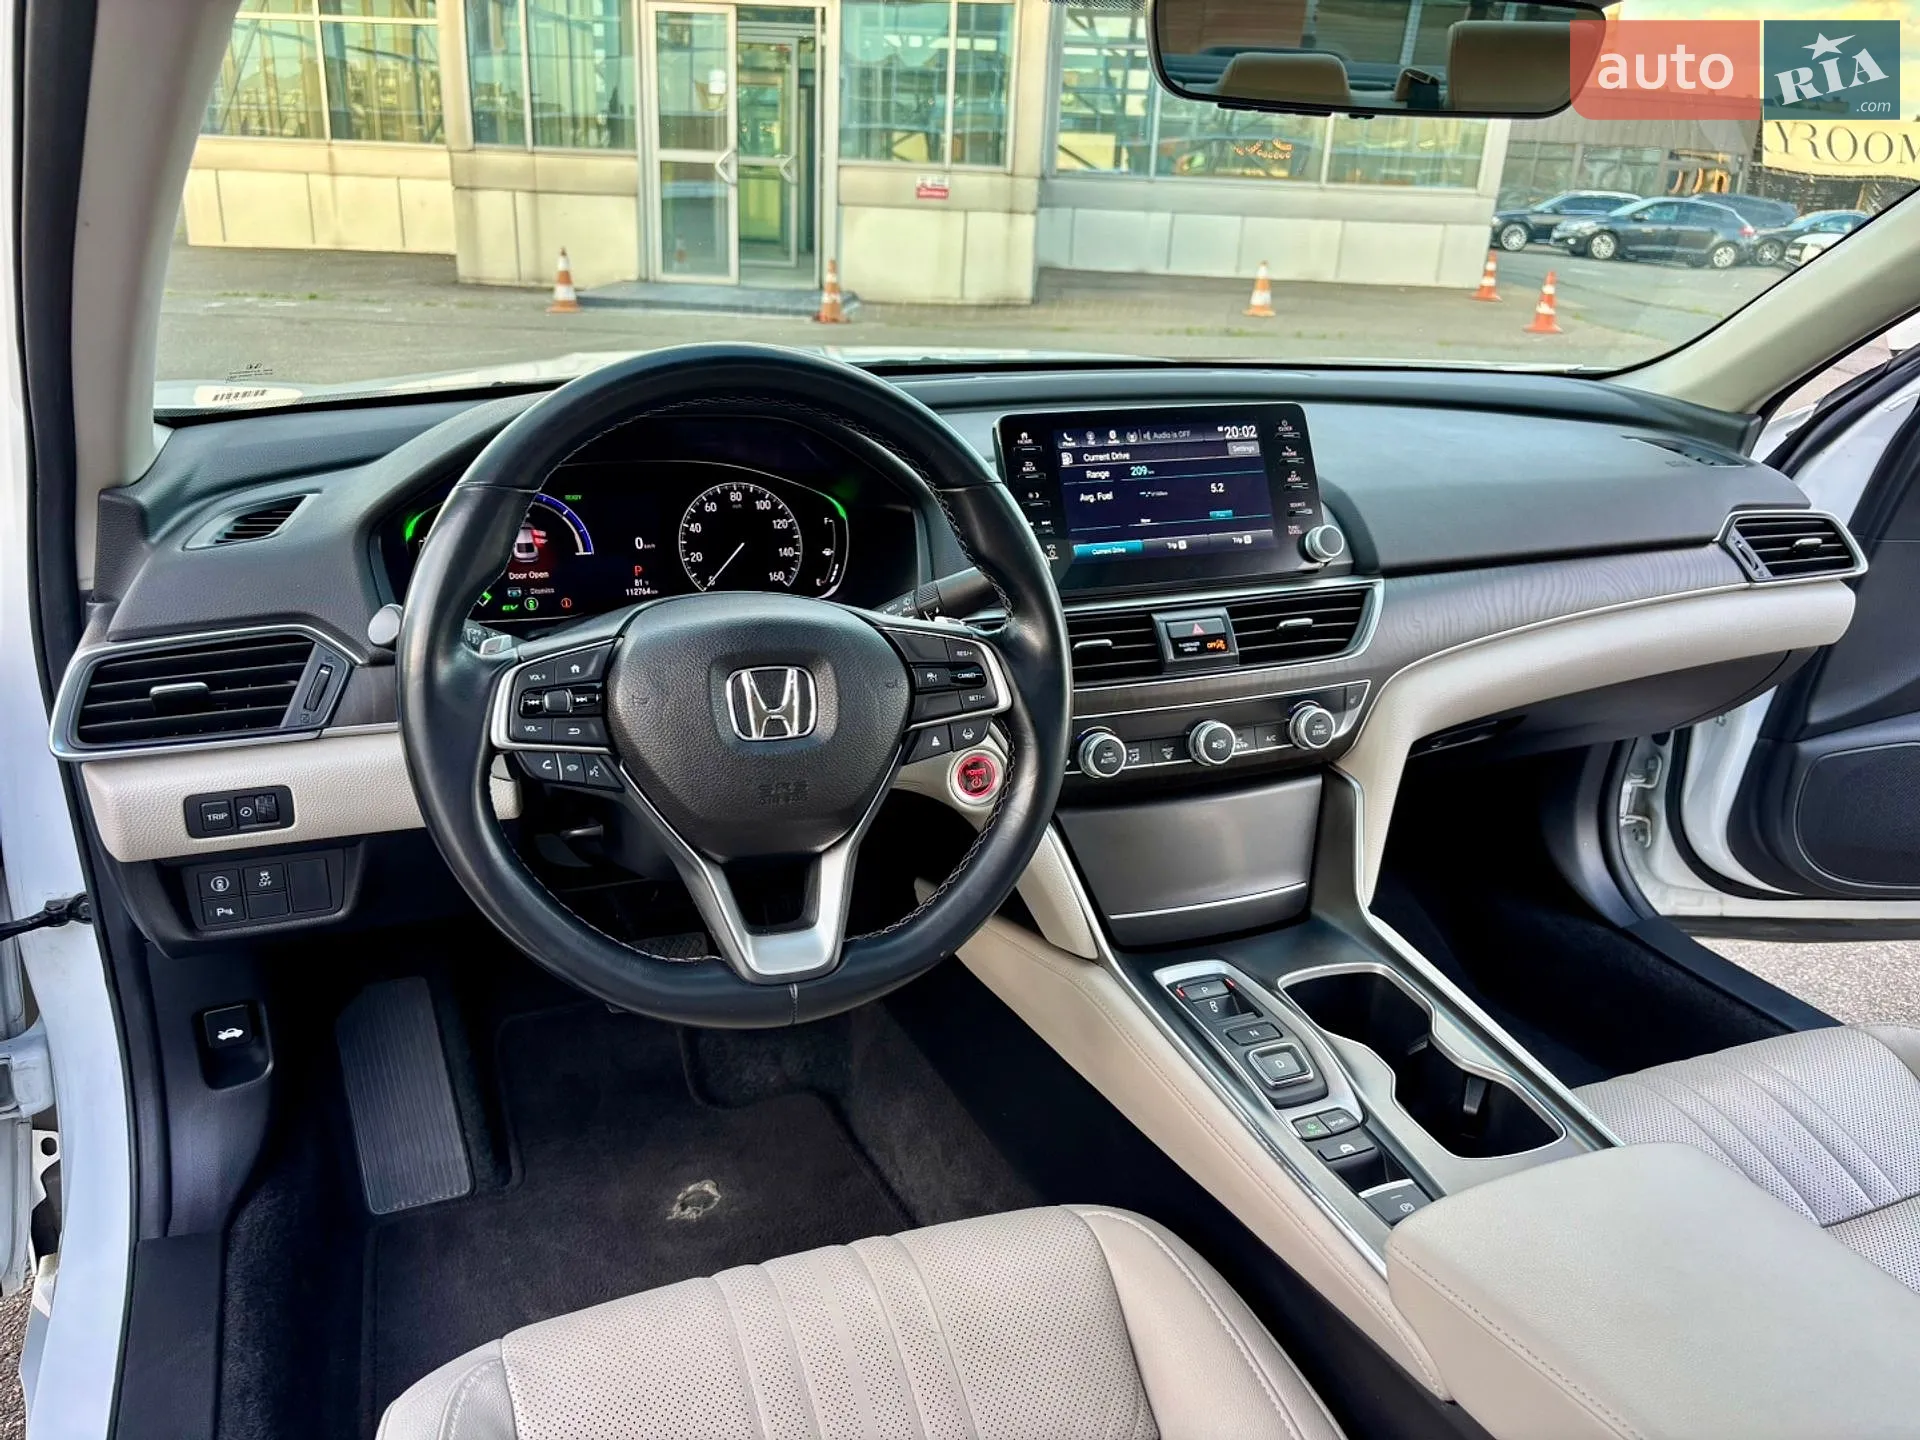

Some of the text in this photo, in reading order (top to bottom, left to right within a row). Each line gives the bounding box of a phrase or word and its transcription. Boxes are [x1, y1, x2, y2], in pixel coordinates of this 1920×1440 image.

[1764, 120, 1920, 164] YROOM
[1153, 431, 1170, 440] Audio
[1178, 430, 1191, 438] OFF
[1223, 425, 1258, 439] 20:02
[1232, 444, 1256, 454] Settings
[1083, 452, 1130, 462] Current Drive
[1085, 469, 1110, 480] Range
[1130, 466, 1147, 476] 209
[1210, 482, 1225, 493] 5.2
[729, 491, 742, 502] 80
[1080, 491, 1114, 503] Avg. Fuel
[704, 502, 718, 512] 60
[755, 500, 772, 510] 100
[689, 522, 702, 534] 40
[772, 518, 788, 530] 120
[634, 536, 644, 550] 0
[690, 552, 703, 562] 20
[778, 547, 794, 558] 140
[508, 570, 550, 580] Door Open
[634, 565, 643, 577] P
[768, 571, 786, 582] 160
[625, 587, 650, 596] 112764
[1266, 734, 1277, 742] A/C
[208, 812, 228, 822] TRIP
[1200, 986, 1208, 994] P
[1248, 1029, 1260, 1038] N
[1274, 1060, 1285, 1069] D
